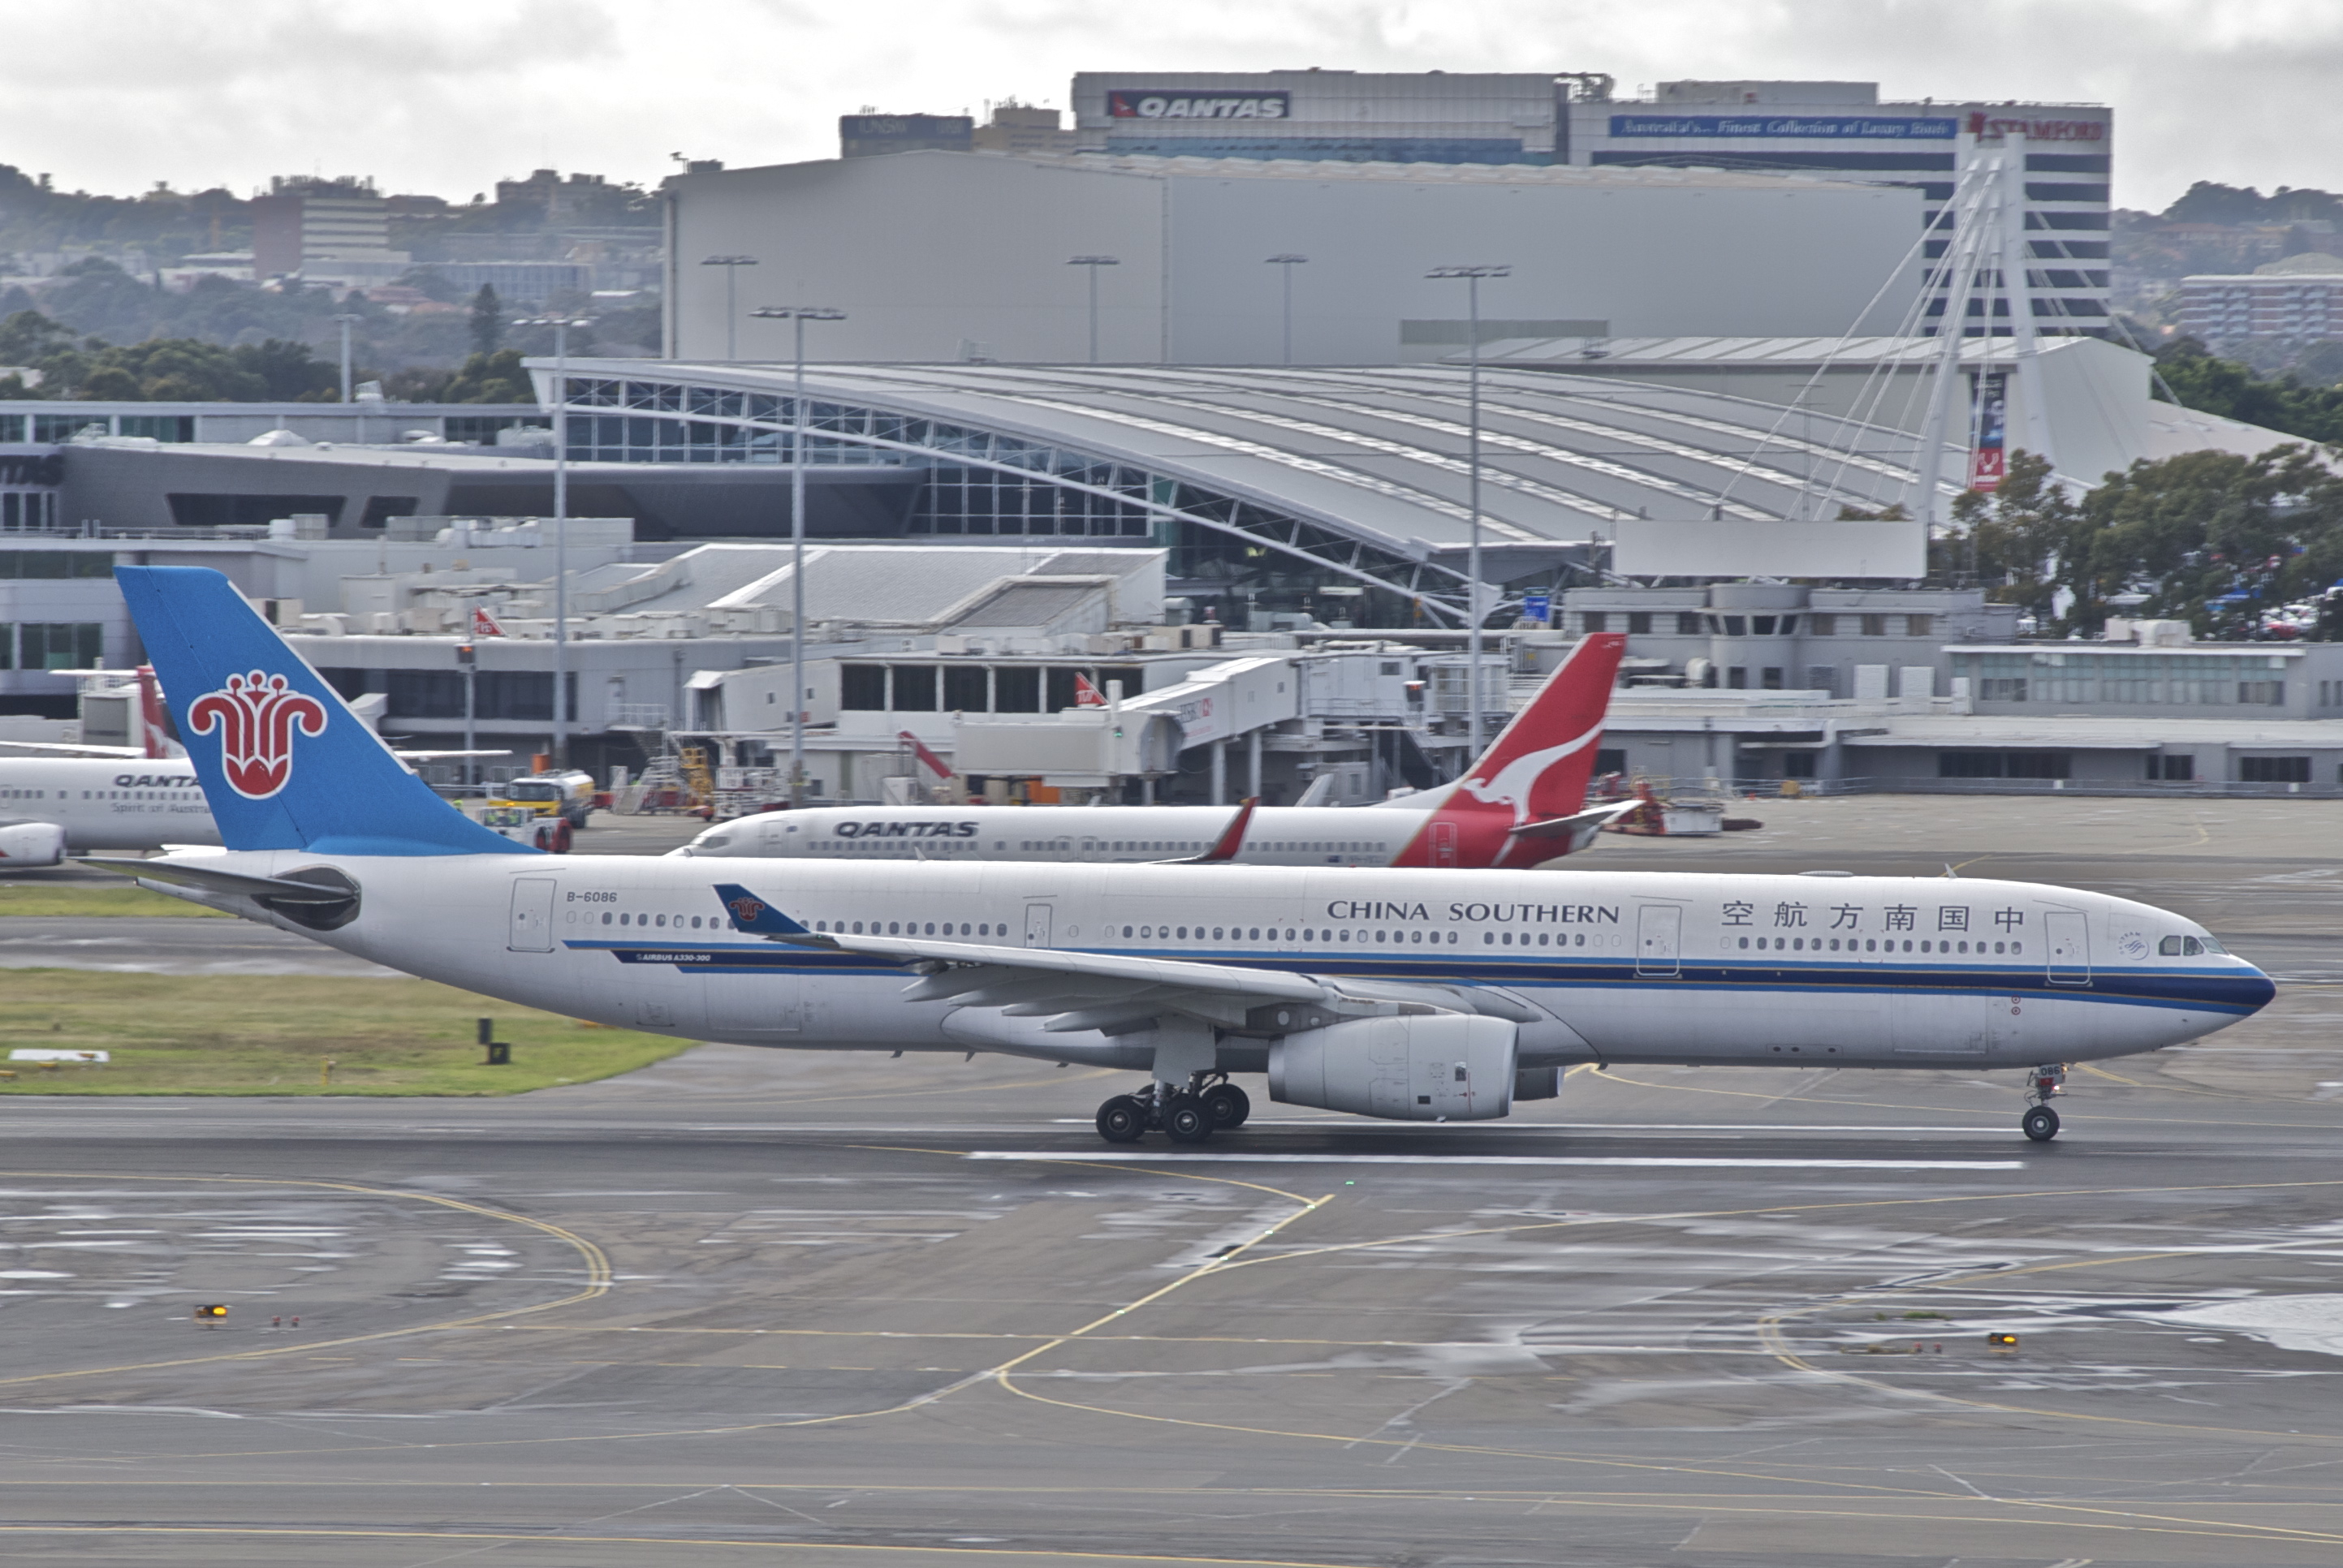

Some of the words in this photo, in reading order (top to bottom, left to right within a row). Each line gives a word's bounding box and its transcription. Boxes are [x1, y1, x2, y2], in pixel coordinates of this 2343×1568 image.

[1137, 97, 1285, 118] QANTAS
[832, 821, 981, 838] QANTAS
[567, 891, 618, 902] B-6086
[1327, 900, 1430, 920] CHINA
[1448, 902, 1620, 924] SOUTHERN
[642, 953, 673, 961] AIRBUS
[673, 954, 711, 962] A330-300
[2040, 1066, 2060, 1076] 086
